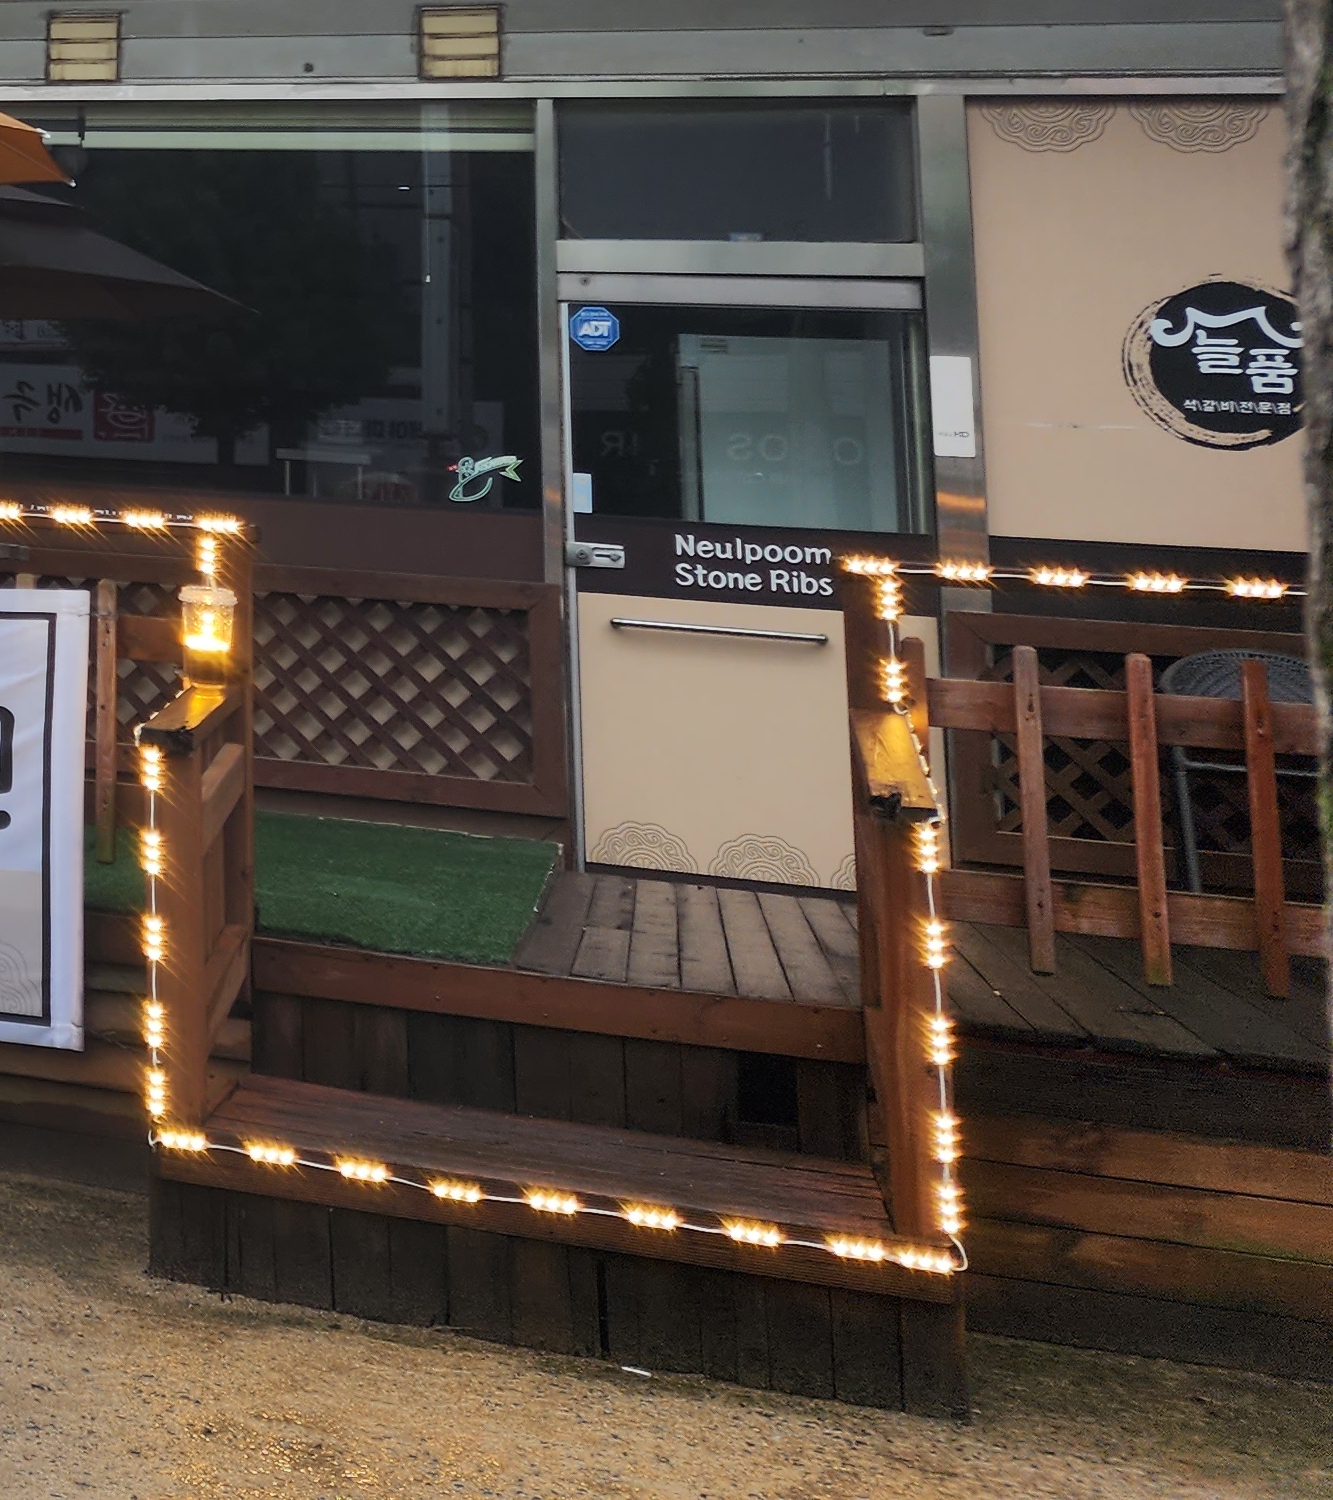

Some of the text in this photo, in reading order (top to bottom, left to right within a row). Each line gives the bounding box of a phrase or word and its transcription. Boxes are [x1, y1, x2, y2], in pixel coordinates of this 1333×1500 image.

[579, 321, 611, 338] ADT
[1191, 329, 1299, 395] 늘품
[674, 533, 832, 564] Neulpoom
[675, 562, 834, 597] Stone Ribs
